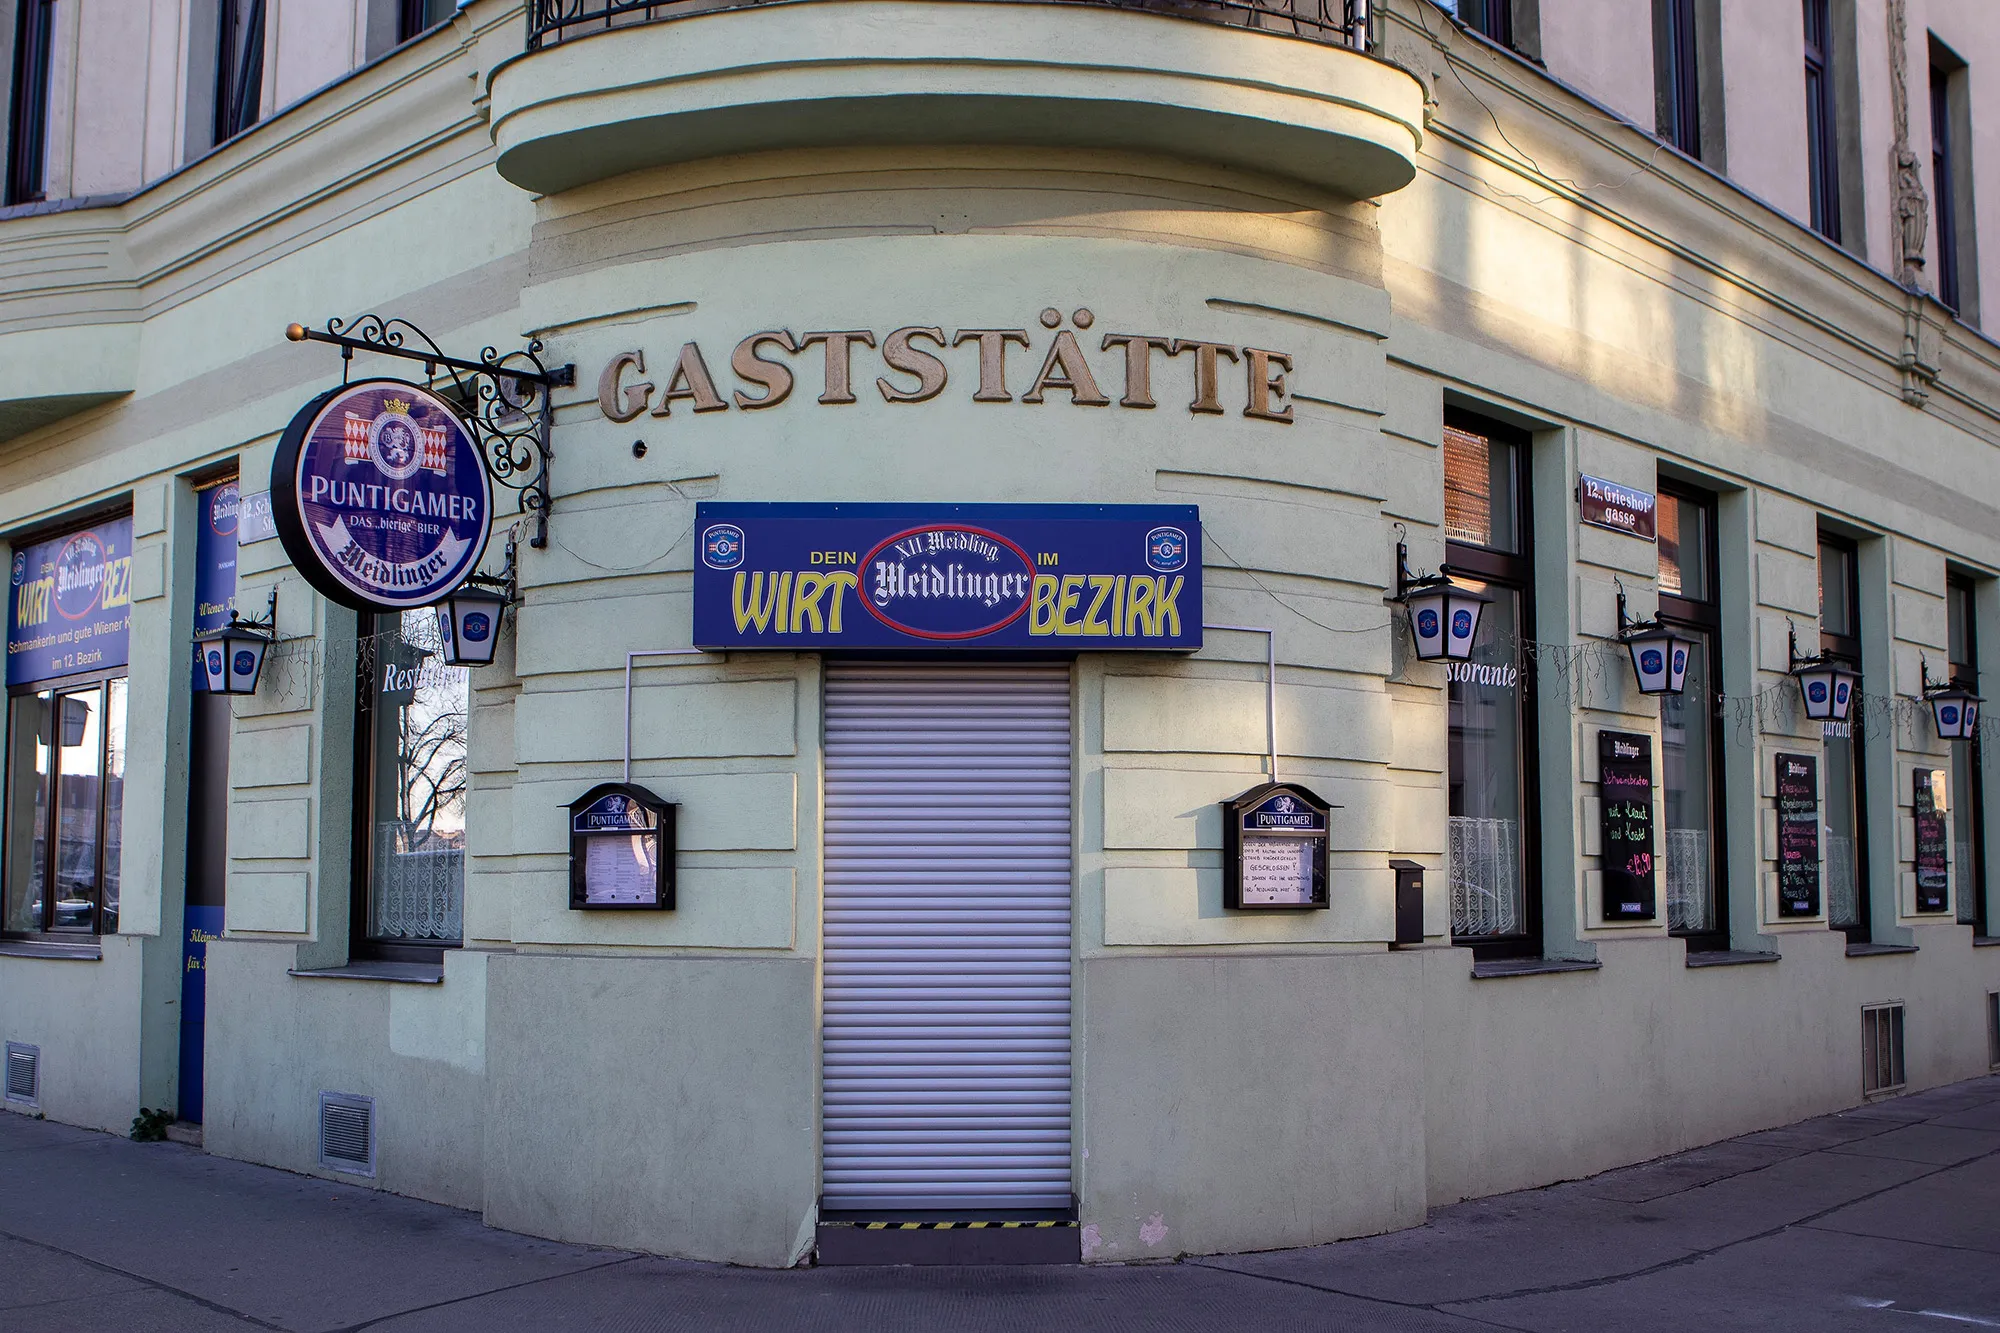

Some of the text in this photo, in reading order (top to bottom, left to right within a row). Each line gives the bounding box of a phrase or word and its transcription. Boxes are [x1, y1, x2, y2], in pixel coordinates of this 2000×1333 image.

[597, 308, 1294, 425] GASTSTÄTTE
[311, 475, 476, 521] PUNTIGAMER
[1604, 485, 1652, 513] Grieshof-
[350, 515, 372, 528] DAS
[417, 523, 440, 535] BIER
[1605, 508, 1636, 526] gasse
[708, 529, 740, 540] PUNTIGAMER
[337, 540, 447, 587] Meidlinger
[810, 551, 857, 565] DEIN
[1037, 552, 1059, 566] IM
[17, 576, 55, 629] WIRT
[57, 562, 105, 600] Meidlinger
[732, 561, 1185, 637] WIRT Meidlinger BEZIRK
[57, 628, 73, 645] und
[74, 625, 92, 644] gute
[93, 619, 123, 637] Wiener
[52, 648, 102, 670] im 12. Bezirk
[1260, 814, 1310, 825] PUNTIGAMER
[1250, 863, 1290, 872] GESCHLOSSEN
[187, 955, 200, 973] für
